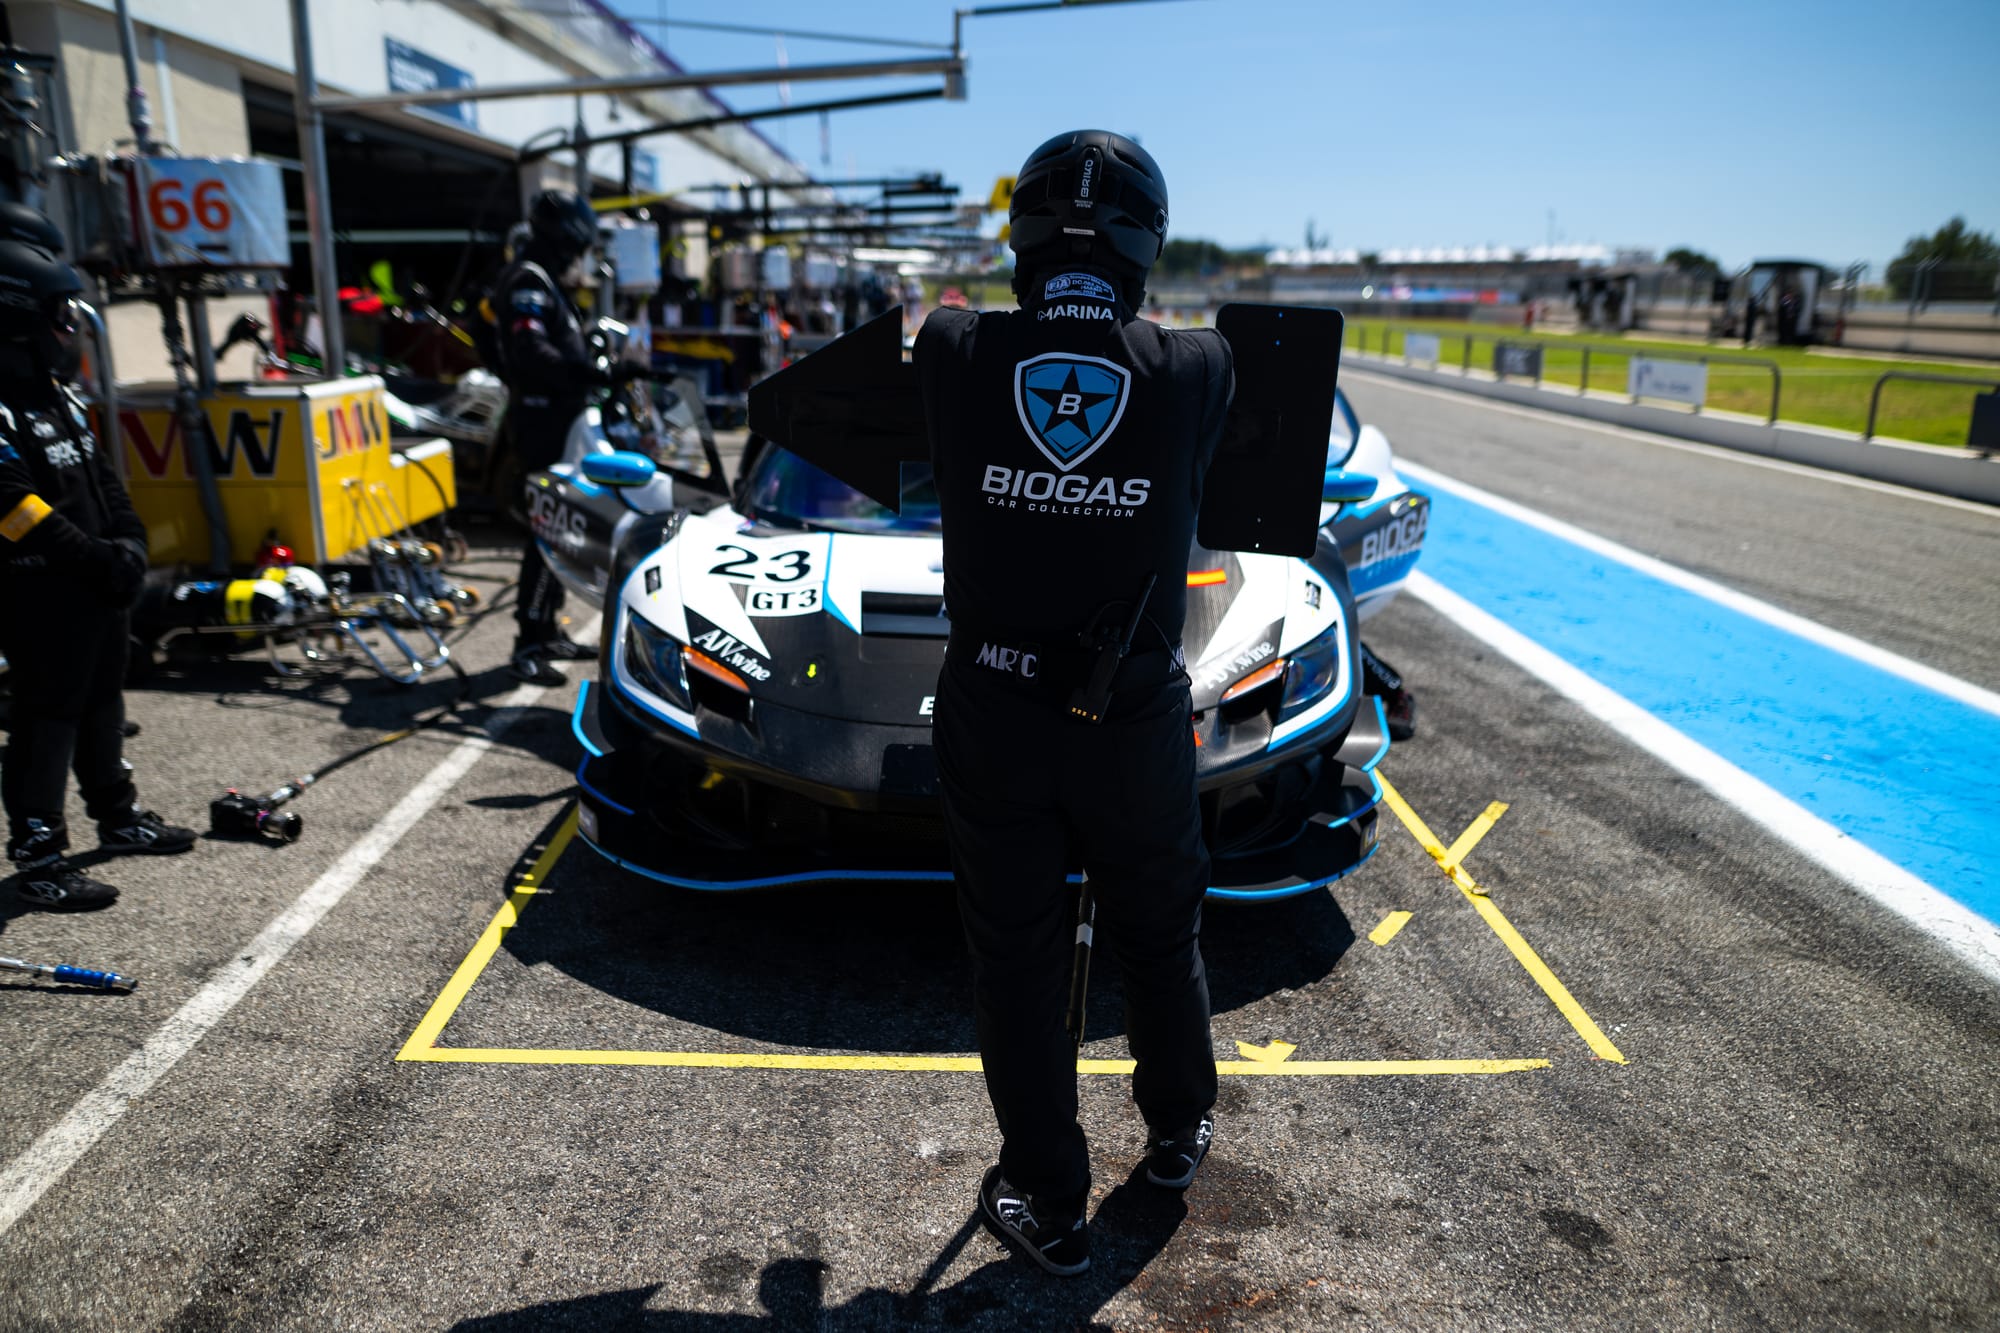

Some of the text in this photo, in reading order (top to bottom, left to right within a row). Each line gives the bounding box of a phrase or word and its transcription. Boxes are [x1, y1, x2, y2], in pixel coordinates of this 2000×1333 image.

[148, 179, 232, 233] 66
[1037, 303, 1114, 321] MARINA
[1057, 393, 1082, 415] B
[981, 464, 1151, 506] BIOGAS
[987, 496, 1135, 517] CAR COLLECTION
[708, 544, 812, 582] 23
[751, 588, 818, 611] GT3
